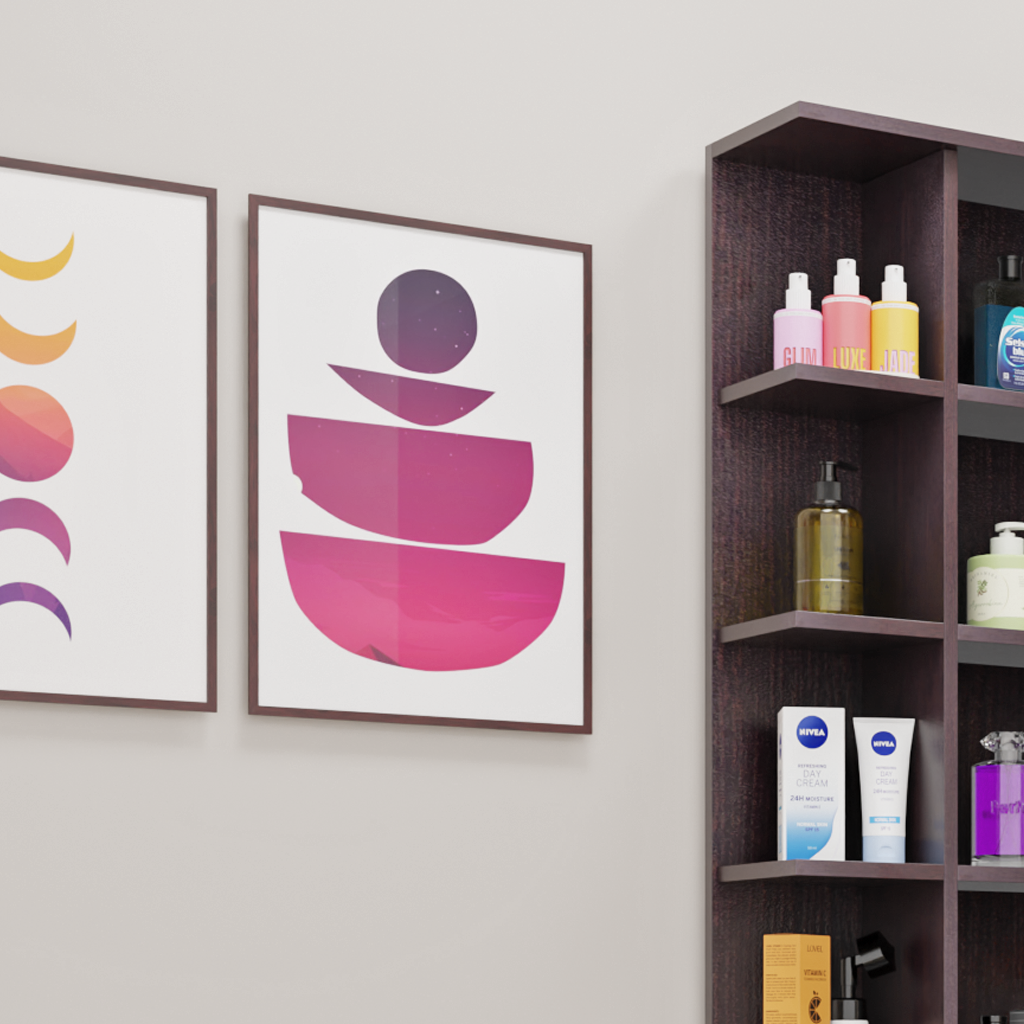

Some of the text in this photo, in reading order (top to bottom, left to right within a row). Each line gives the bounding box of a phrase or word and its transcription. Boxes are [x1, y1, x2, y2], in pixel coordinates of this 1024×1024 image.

[833, 346, 866, 370] LUXE
[879, 349, 916, 375] JADE
[799, 728, 826, 736] NIVEA
[873, 740, 895, 748] NIVEA
[803, 769, 821, 778] DAY
[880, 770, 894, 778] DAY
[796, 778, 829, 788] CREAM
[875, 778, 899, 786] CREAM
